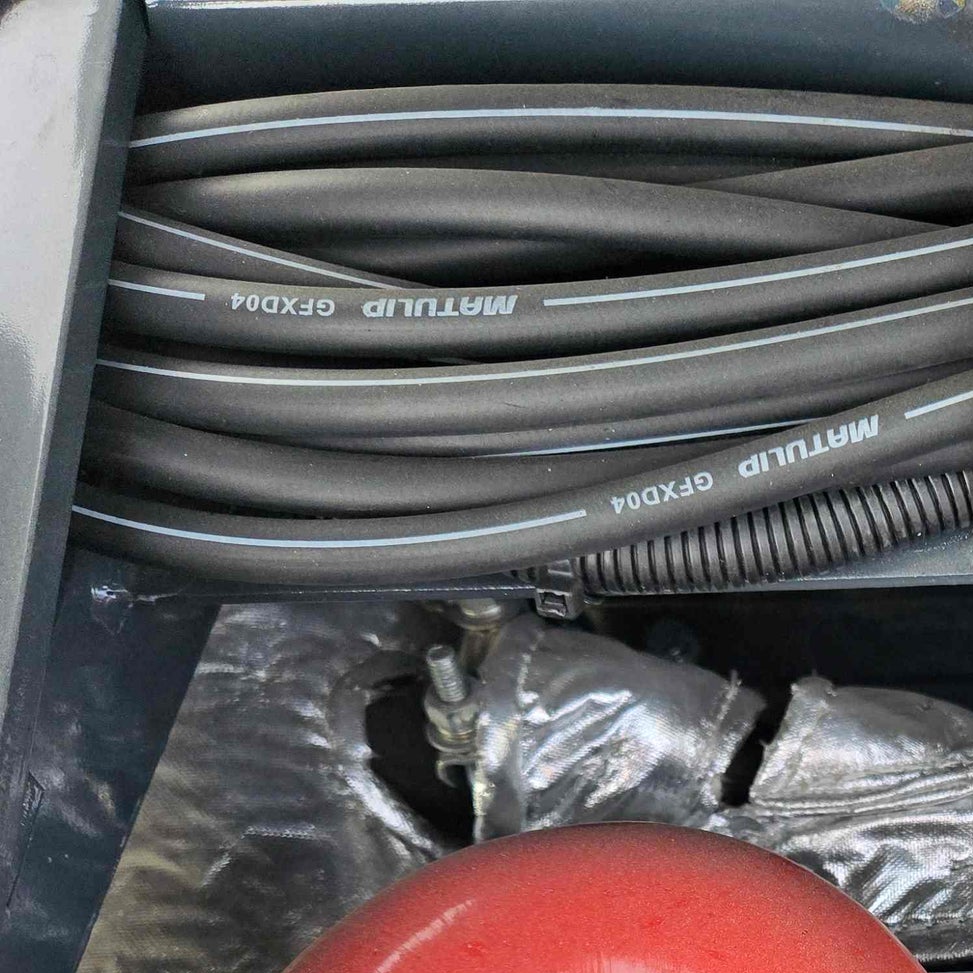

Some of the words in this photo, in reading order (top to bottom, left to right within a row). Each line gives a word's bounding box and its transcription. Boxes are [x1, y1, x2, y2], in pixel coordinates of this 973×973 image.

[230, 292, 335, 315] GFXD04
[363, 295, 518, 319] MATULIP
[737, 413, 880, 479] MATULIP
[608, 470, 714, 515] GFXD04
